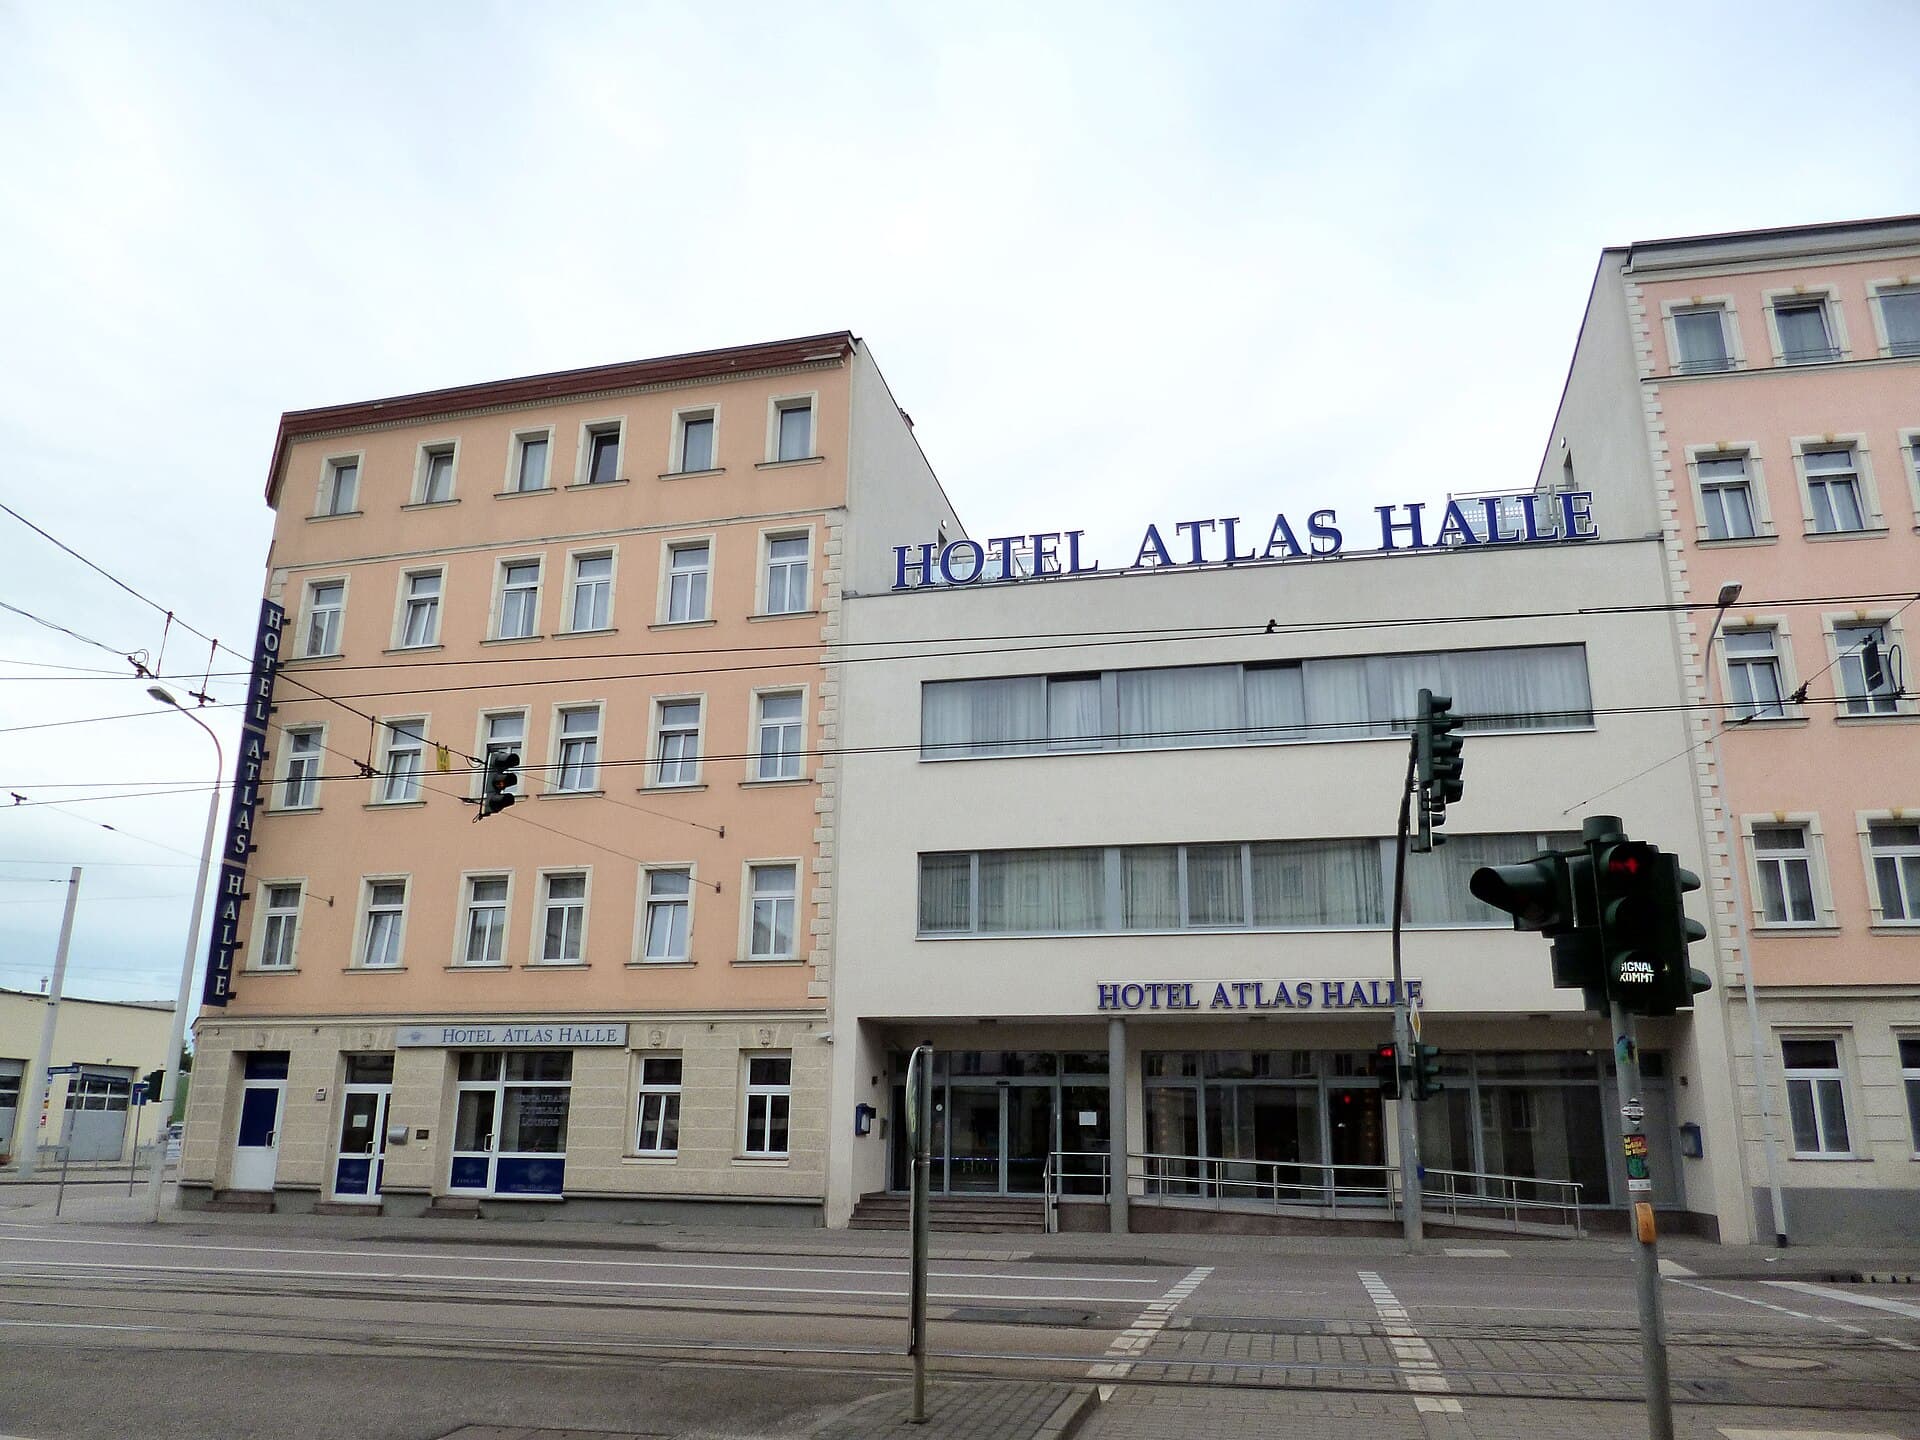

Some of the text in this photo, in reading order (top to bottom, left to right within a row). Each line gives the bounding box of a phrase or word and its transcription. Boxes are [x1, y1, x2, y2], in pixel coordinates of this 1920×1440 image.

[891, 490, 1600, 591] HOTEL ATLAS HALLE
[214, 607, 282, 997] HOTEL ATLAS HALLE
[1097, 983, 1200, 1010] HOTEL
[1209, 981, 1313, 1009] ATLAS
[442, 1027, 618, 1043] HOTEL ATLAS HALLE
